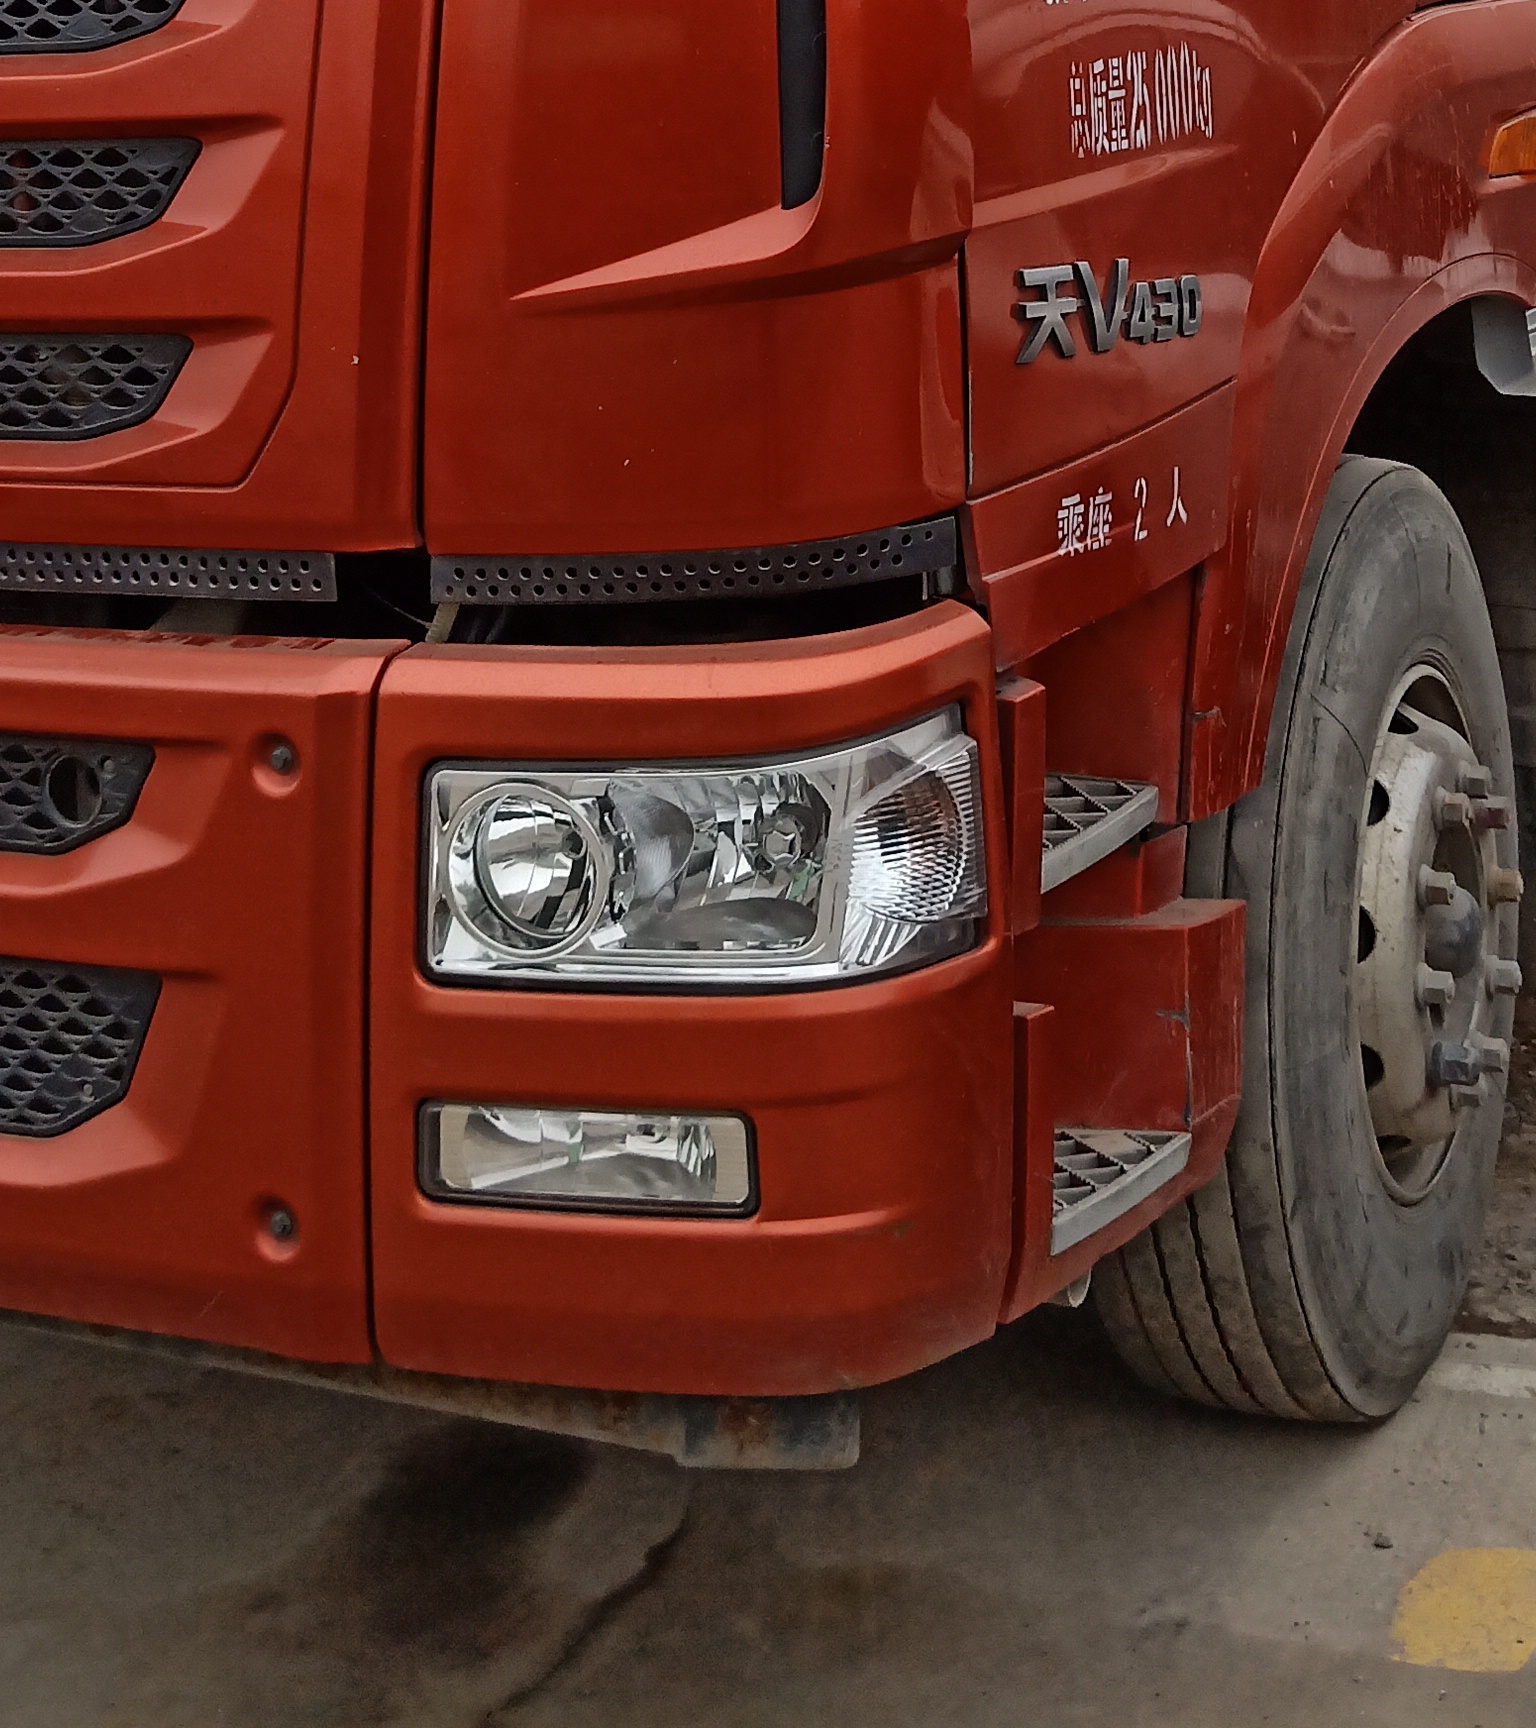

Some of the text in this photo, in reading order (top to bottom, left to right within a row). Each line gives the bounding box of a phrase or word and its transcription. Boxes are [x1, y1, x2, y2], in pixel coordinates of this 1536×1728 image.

[1057, 466, 1189, 557] 乘座 2 人
